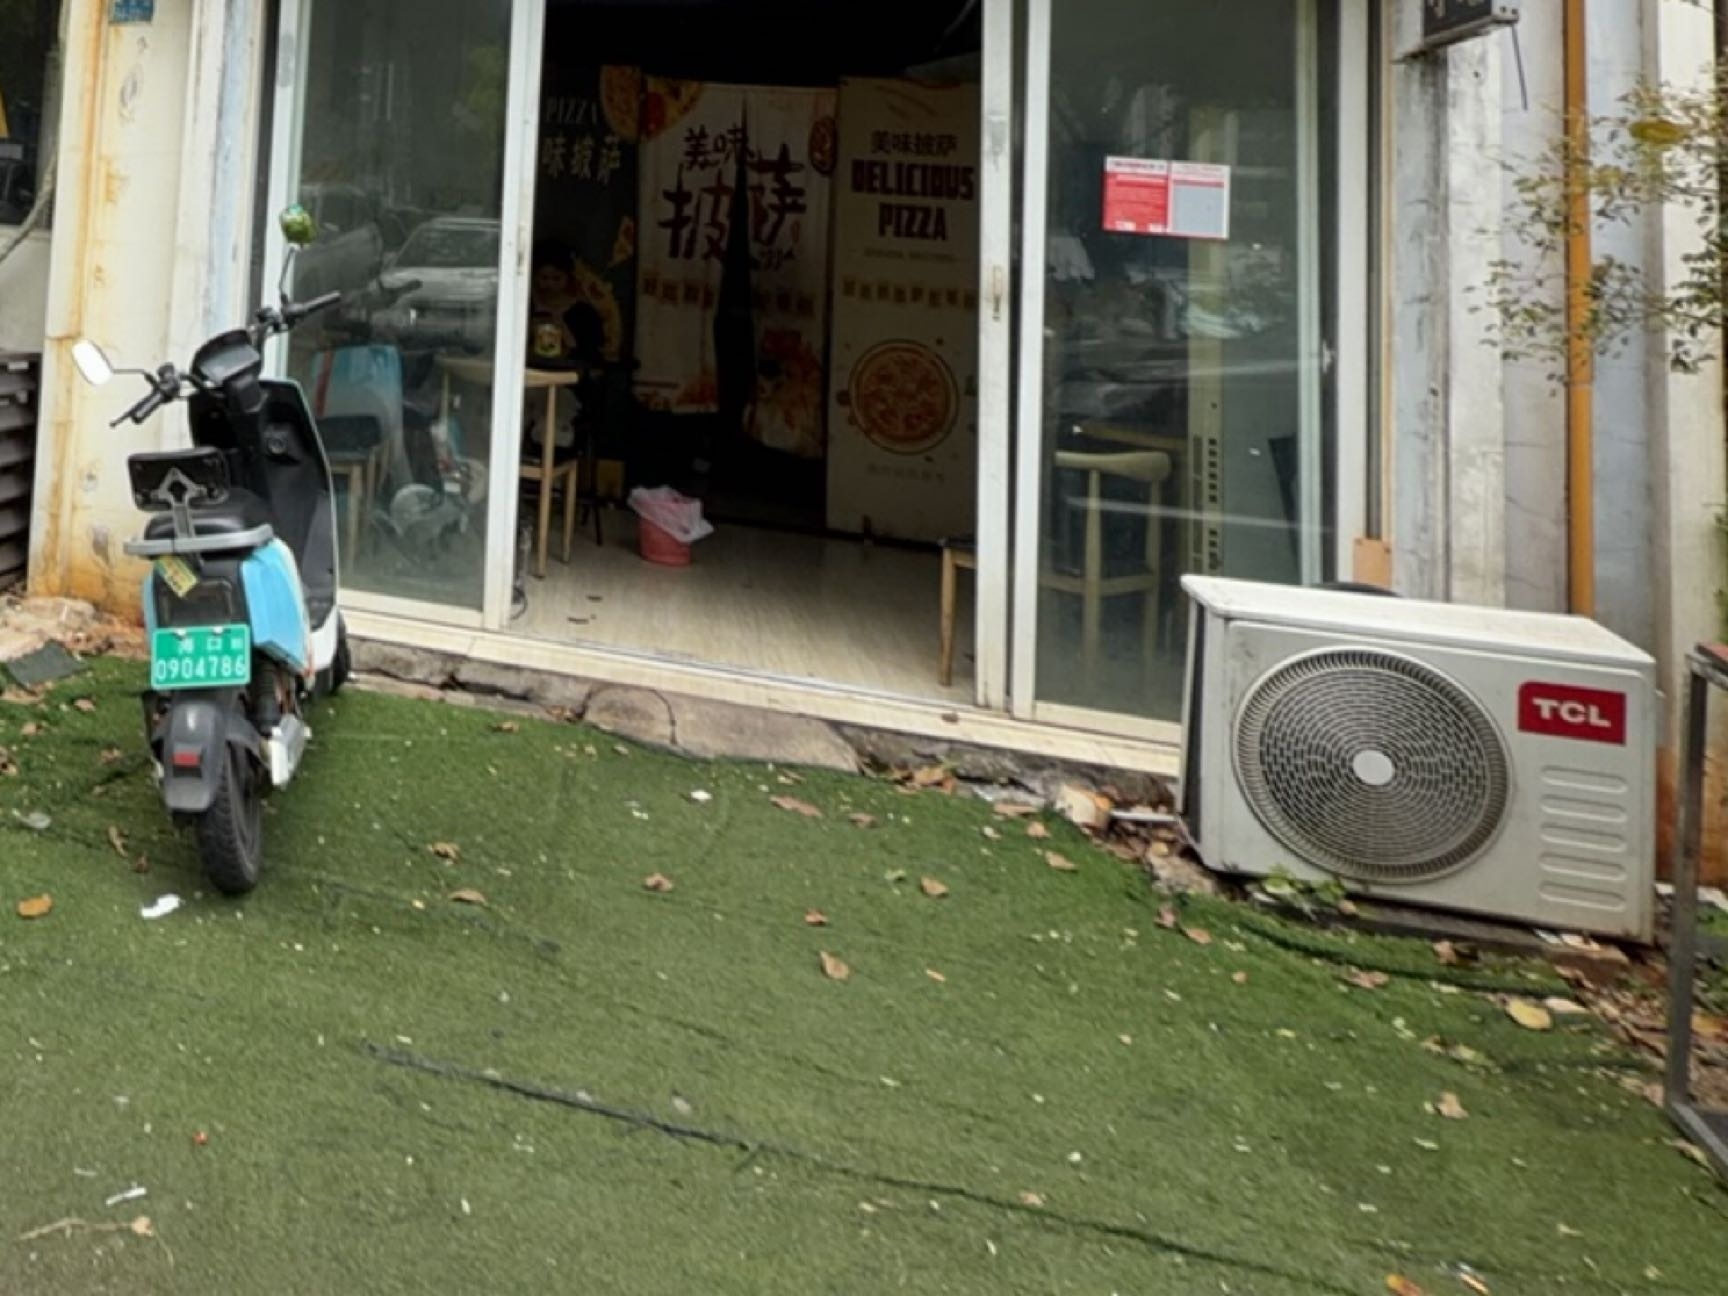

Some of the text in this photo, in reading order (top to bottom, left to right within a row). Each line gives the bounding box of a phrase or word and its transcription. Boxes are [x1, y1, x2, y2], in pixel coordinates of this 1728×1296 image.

[545, 95, 600, 126] PIZZ
[852, 158, 975, 201] DELICIOUS
[878, 203, 948, 241] PIZZA
[156, 655, 246, 682] 0904786
[1531, 697, 1613, 728] TCL
